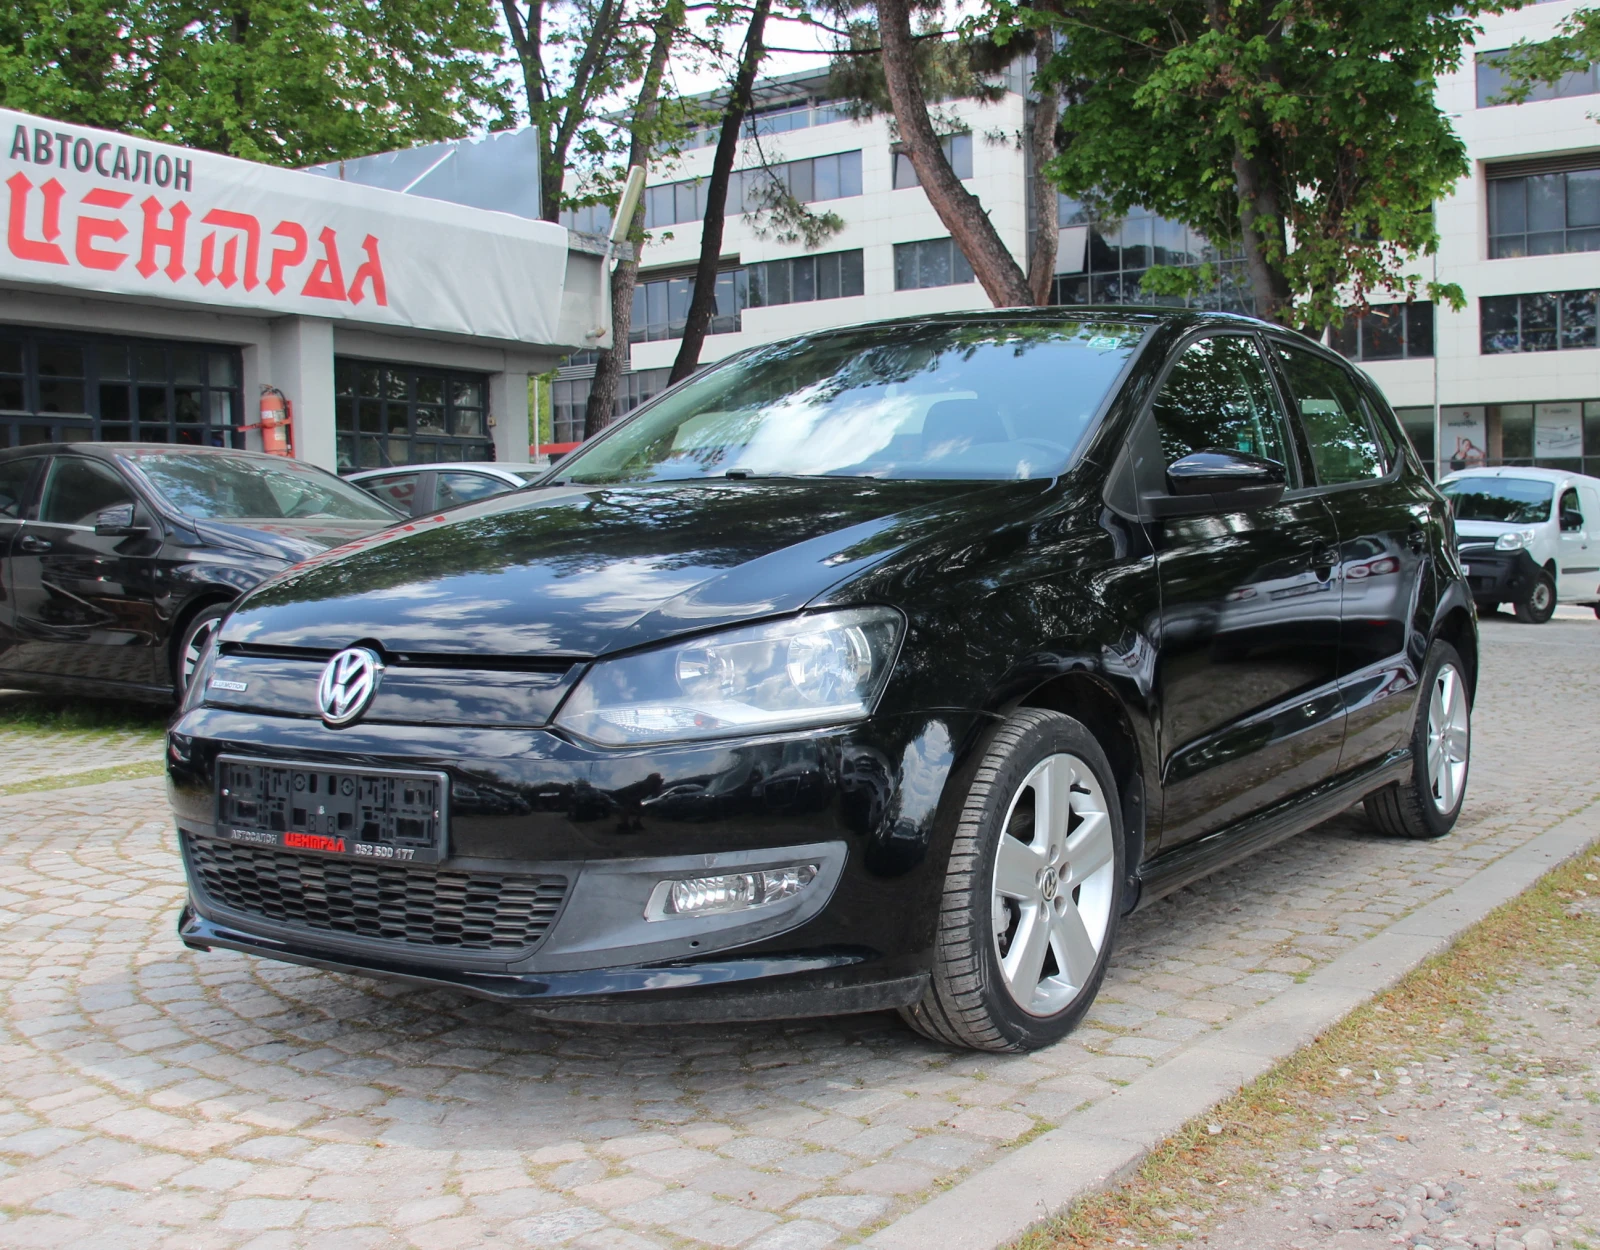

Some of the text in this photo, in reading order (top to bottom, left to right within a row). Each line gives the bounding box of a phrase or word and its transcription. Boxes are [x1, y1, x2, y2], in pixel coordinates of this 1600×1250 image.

[10, 124, 193, 192] АВТОСАЛОН
[318, 648, 377, 724] VW
[354, 843, 373, 857] 052
[374, 846, 394, 858] 500
[396, 848, 415, 860] 177
